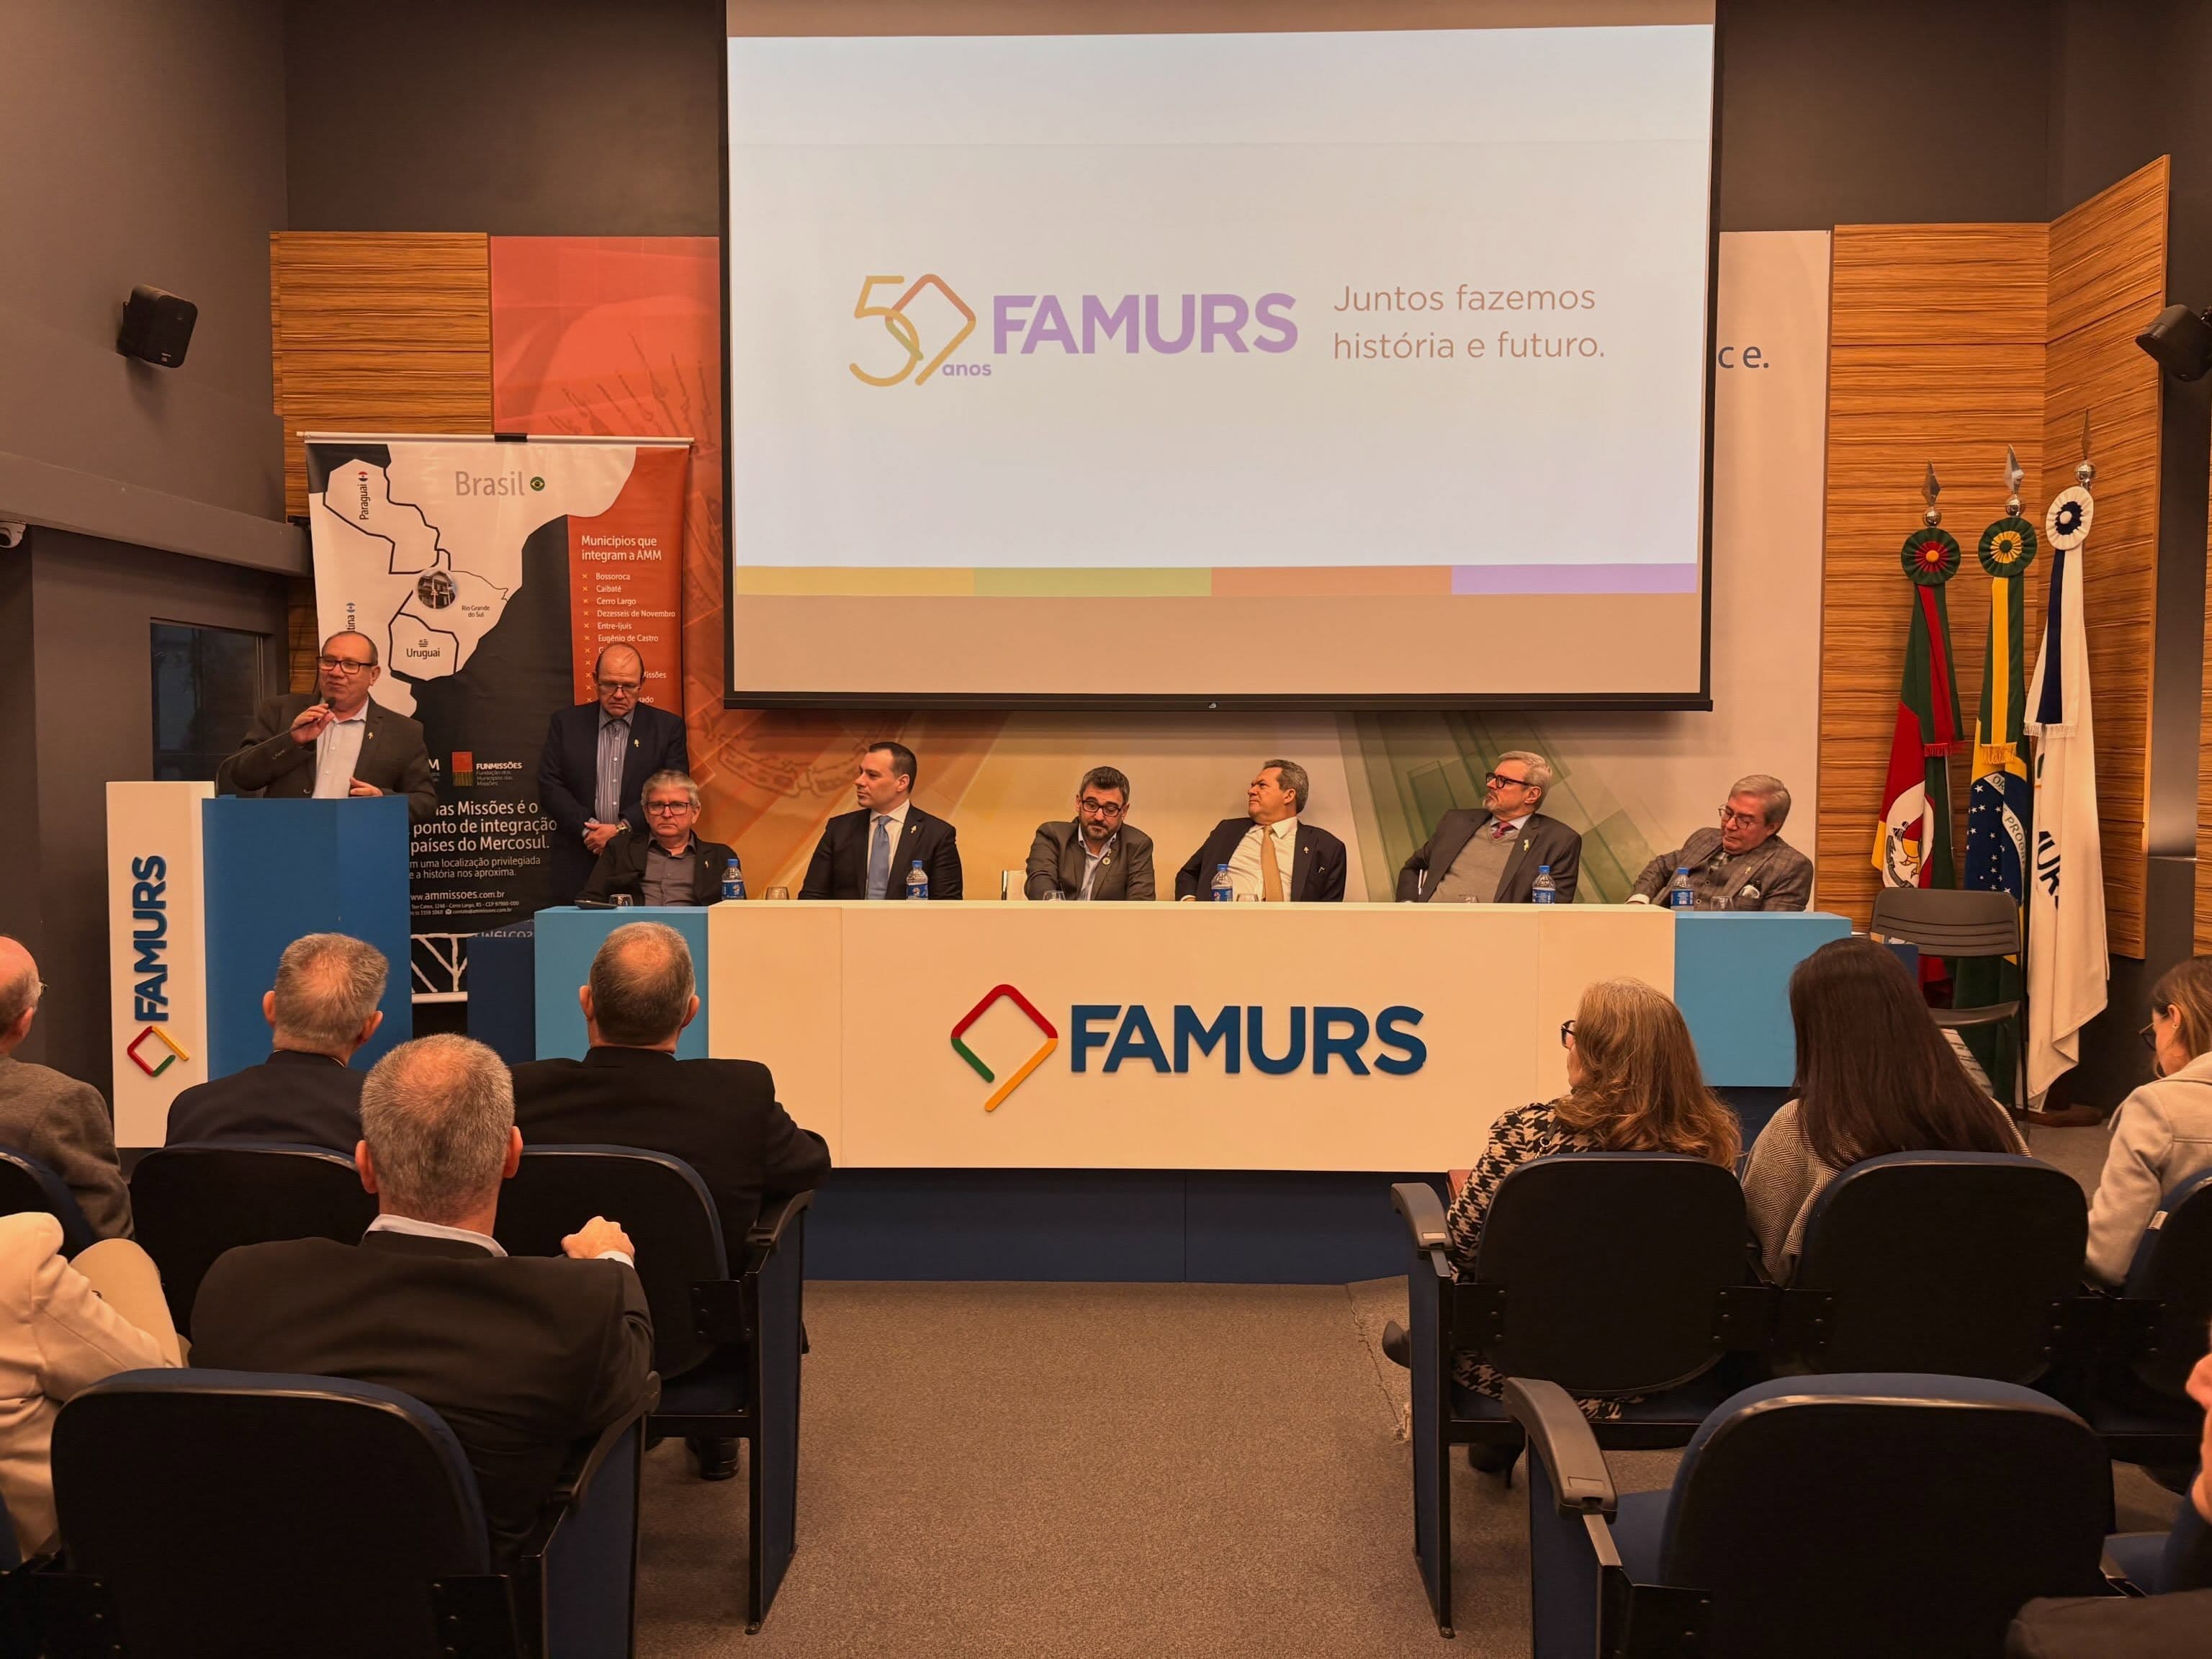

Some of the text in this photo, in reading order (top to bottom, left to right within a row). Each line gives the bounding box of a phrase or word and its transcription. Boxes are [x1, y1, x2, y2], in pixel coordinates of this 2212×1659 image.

[1334, 284, 1596, 311] Juntos fazemos
[993, 292, 1298, 354] FAMURS
[1334, 331, 1604, 359] história e futuro.
[1718, 346, 1769, 369] ce.
[942, 362, 992, 377] anos
[455, 471, 524, 496] Brasil
[357, 485, 370, 520] Paraguai
[638, 538, 657, 548] que
[582, 549, 626, 562] integram
[637, 550, 662, 560] AMM
[617, 598, 637, 606] Largo
[346, 615, 355, 630] tina
[598, 634, 625, 643] Eugênio
[406, 648, 440, 660] Uruguai
[476, 761, 523, 770] FUNMISSÕES
[458, 801, 514, 816] Missões
[517, 800, 525, 814] é
[529, 802, 538, 814] o
[413, 817, 557, 837] ponto de integração
[411, 835, 549, 855] países do Mercosul.
[441, 857, 490, 870] localização
[492, 856, 541, 868] privilegiada
[423, 868, 454, 878] história
[475, 868, 516, 879] aproxima.
[410, 890, 505, 901] ww.ammissoes.com.br
[132, 855, 168, 1022] FAMURS
[1071, 1004, 1427, 1075] FAMURS
